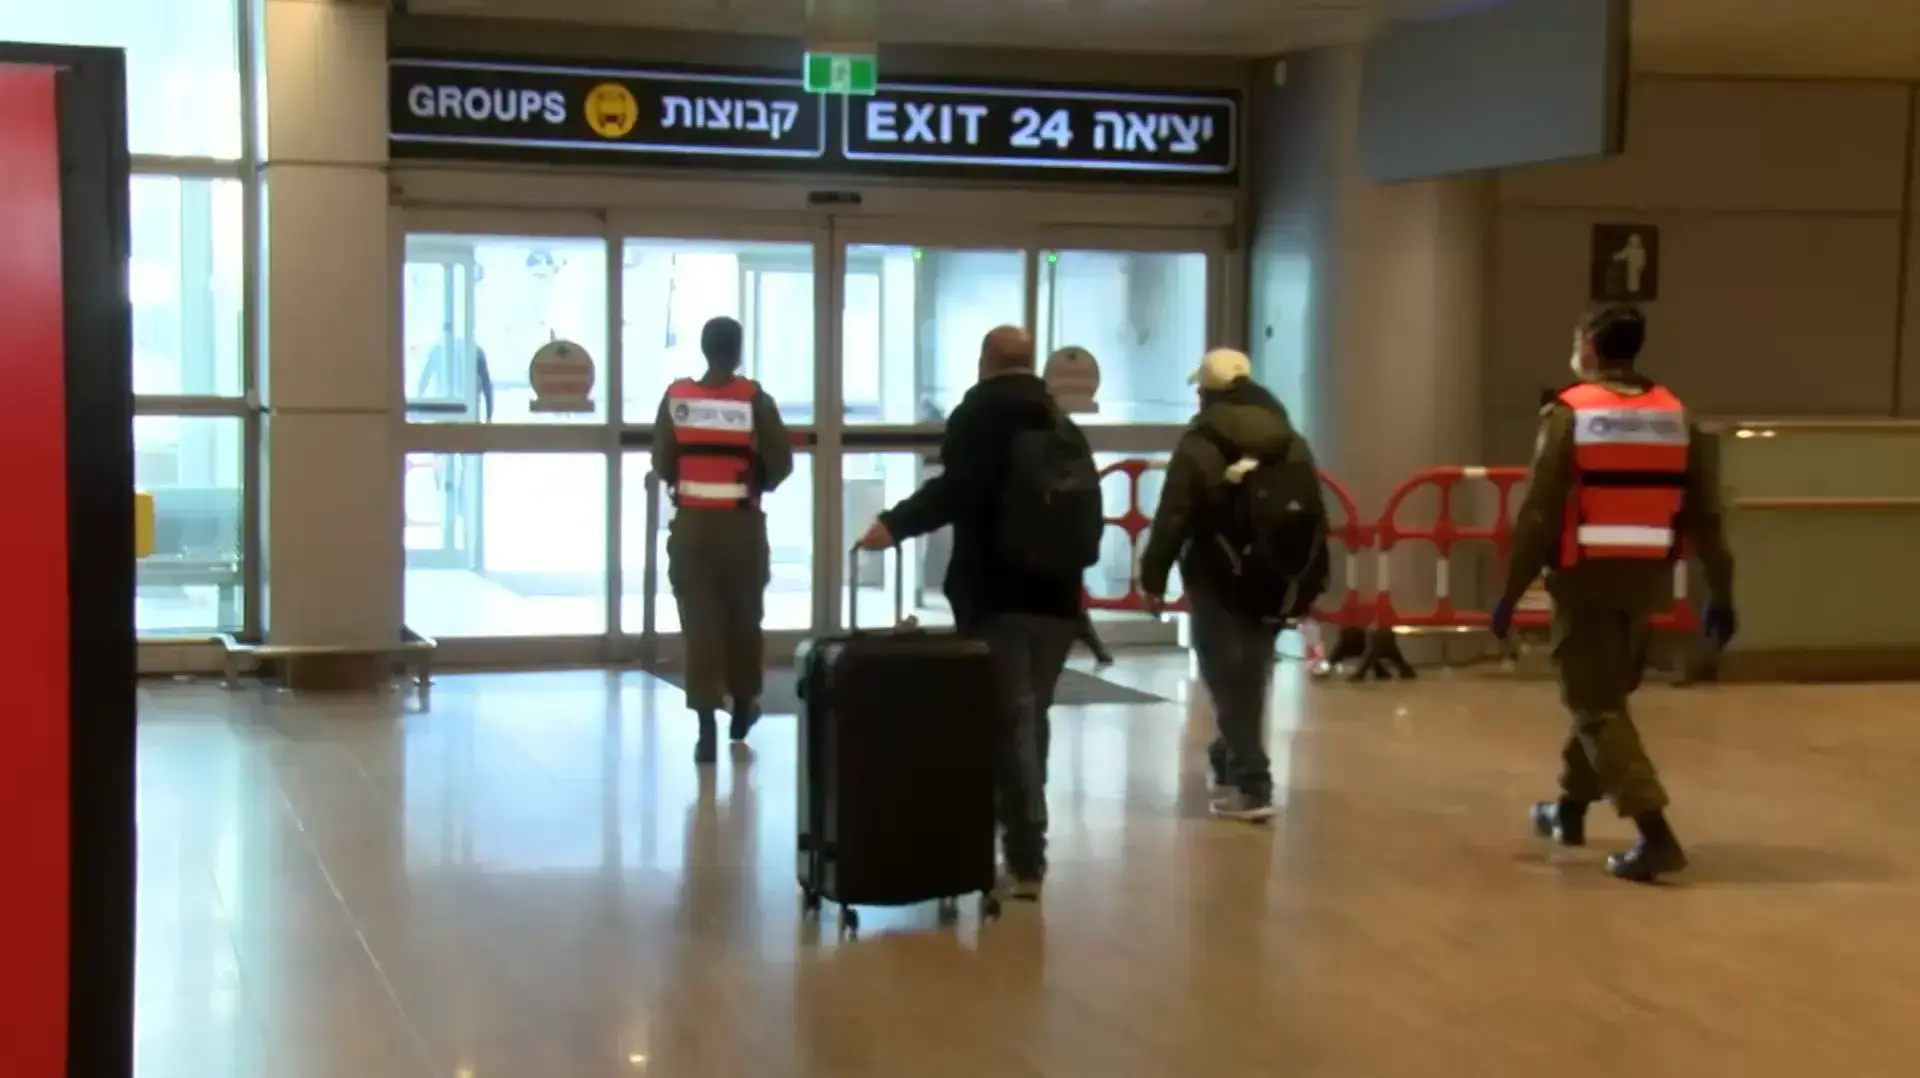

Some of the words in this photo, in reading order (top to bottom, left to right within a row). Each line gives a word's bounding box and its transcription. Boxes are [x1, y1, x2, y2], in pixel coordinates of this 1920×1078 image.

[408, 83, 567, 124] GROUPS
[661, 94, 799, 139] קבוצות
[866, 101, 988, 144] EXIT
[1010, 107, 1073, 149] 24
[1093, 110, 1214, 153] יציאה
